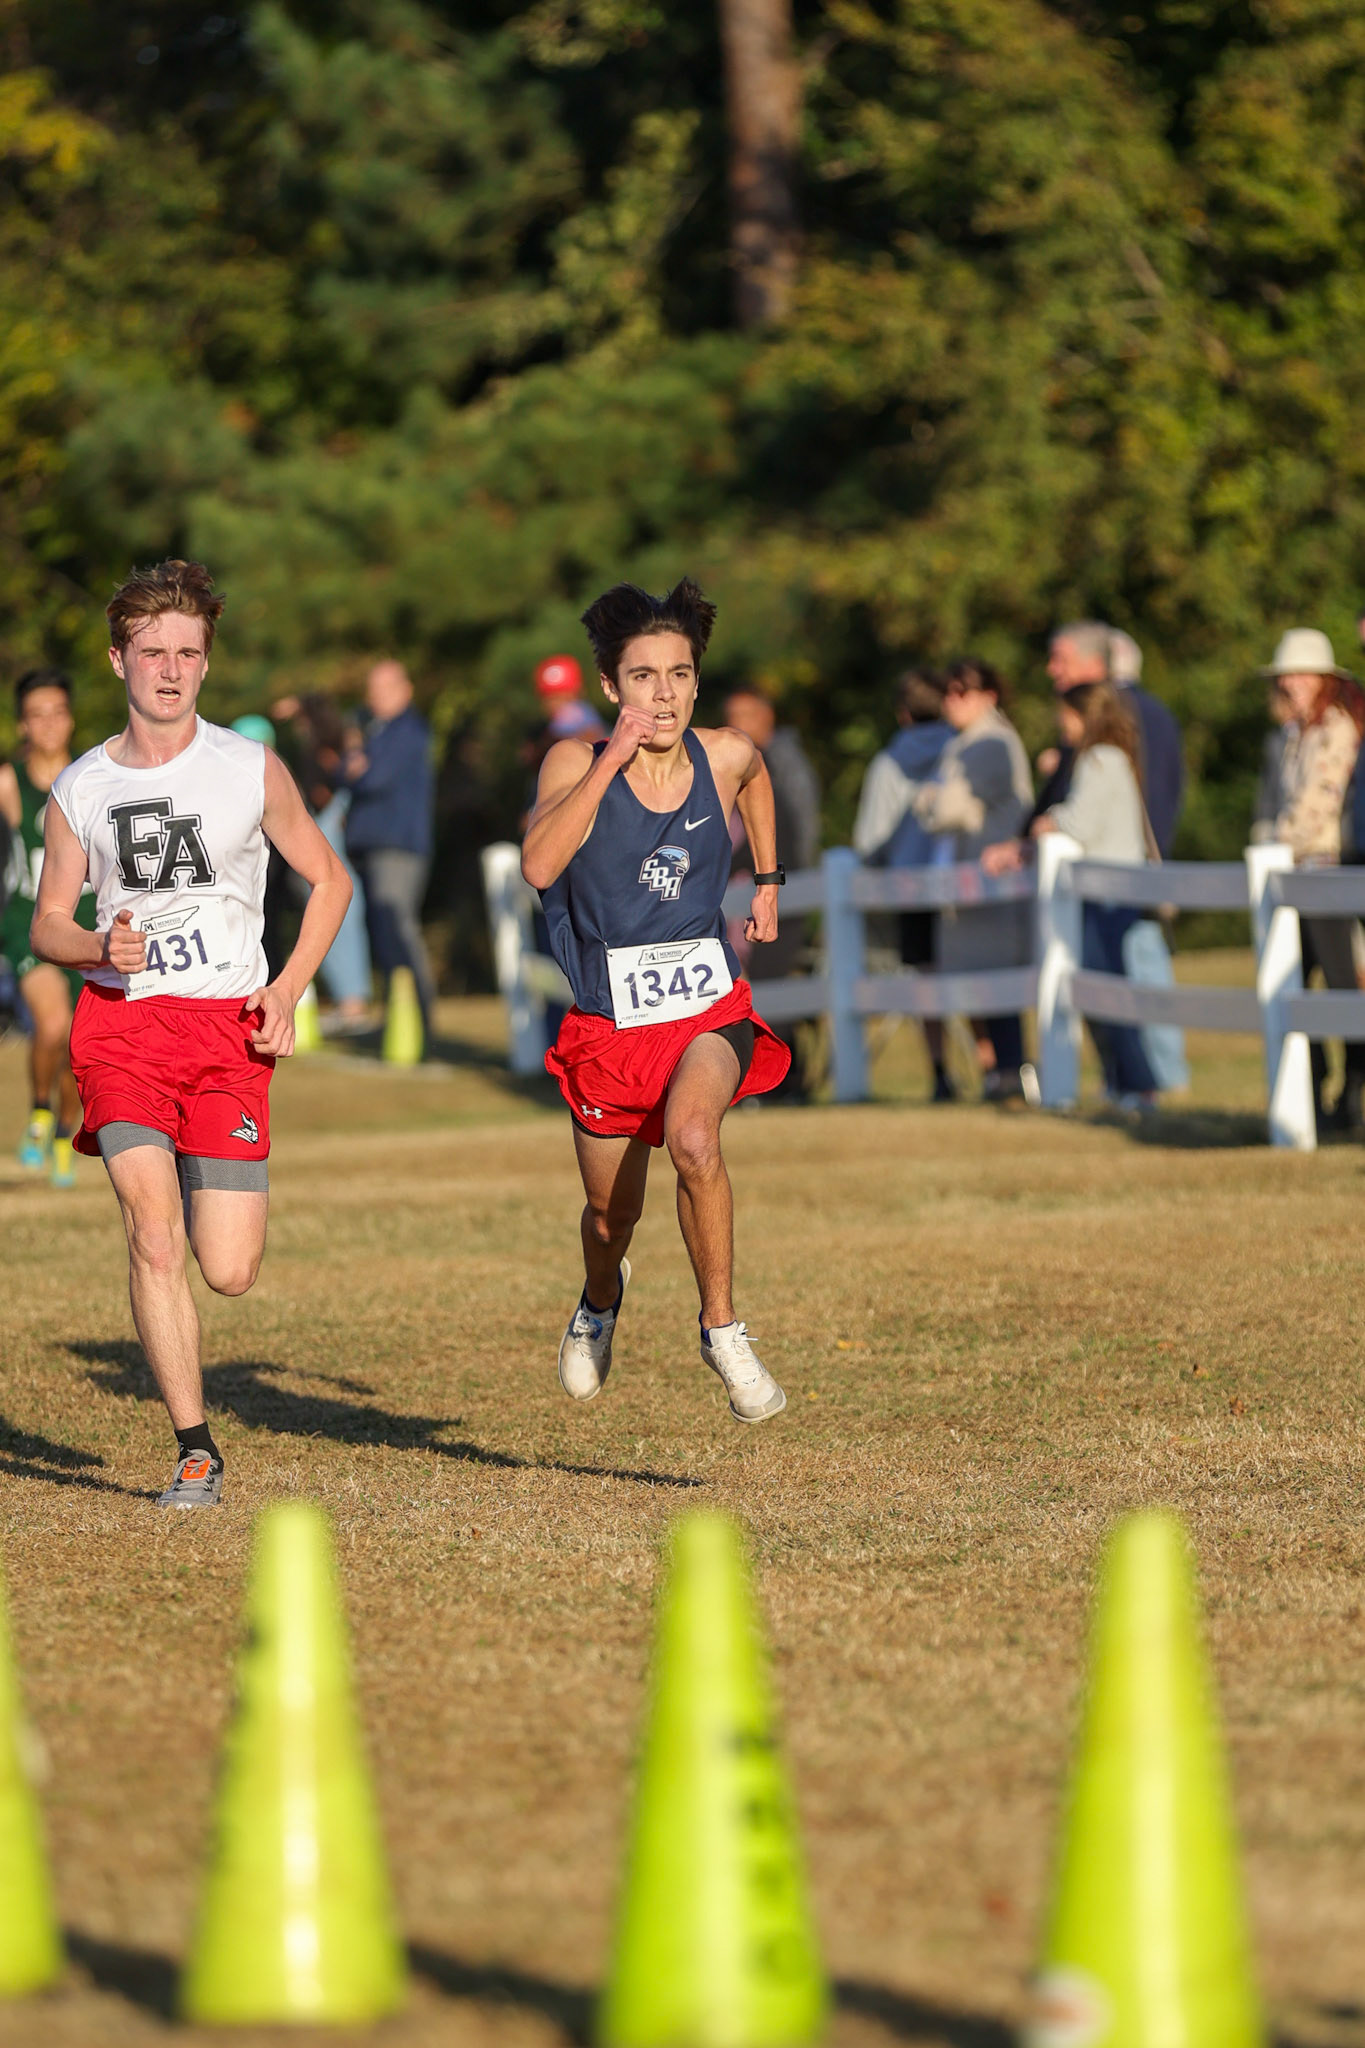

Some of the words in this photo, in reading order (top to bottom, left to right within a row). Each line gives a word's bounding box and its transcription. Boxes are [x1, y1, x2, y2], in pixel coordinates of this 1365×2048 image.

[108, 797, 216, 893] EA
[640, 858, 682, 899] SBA
[624, 963, 719, 1009] 1342
